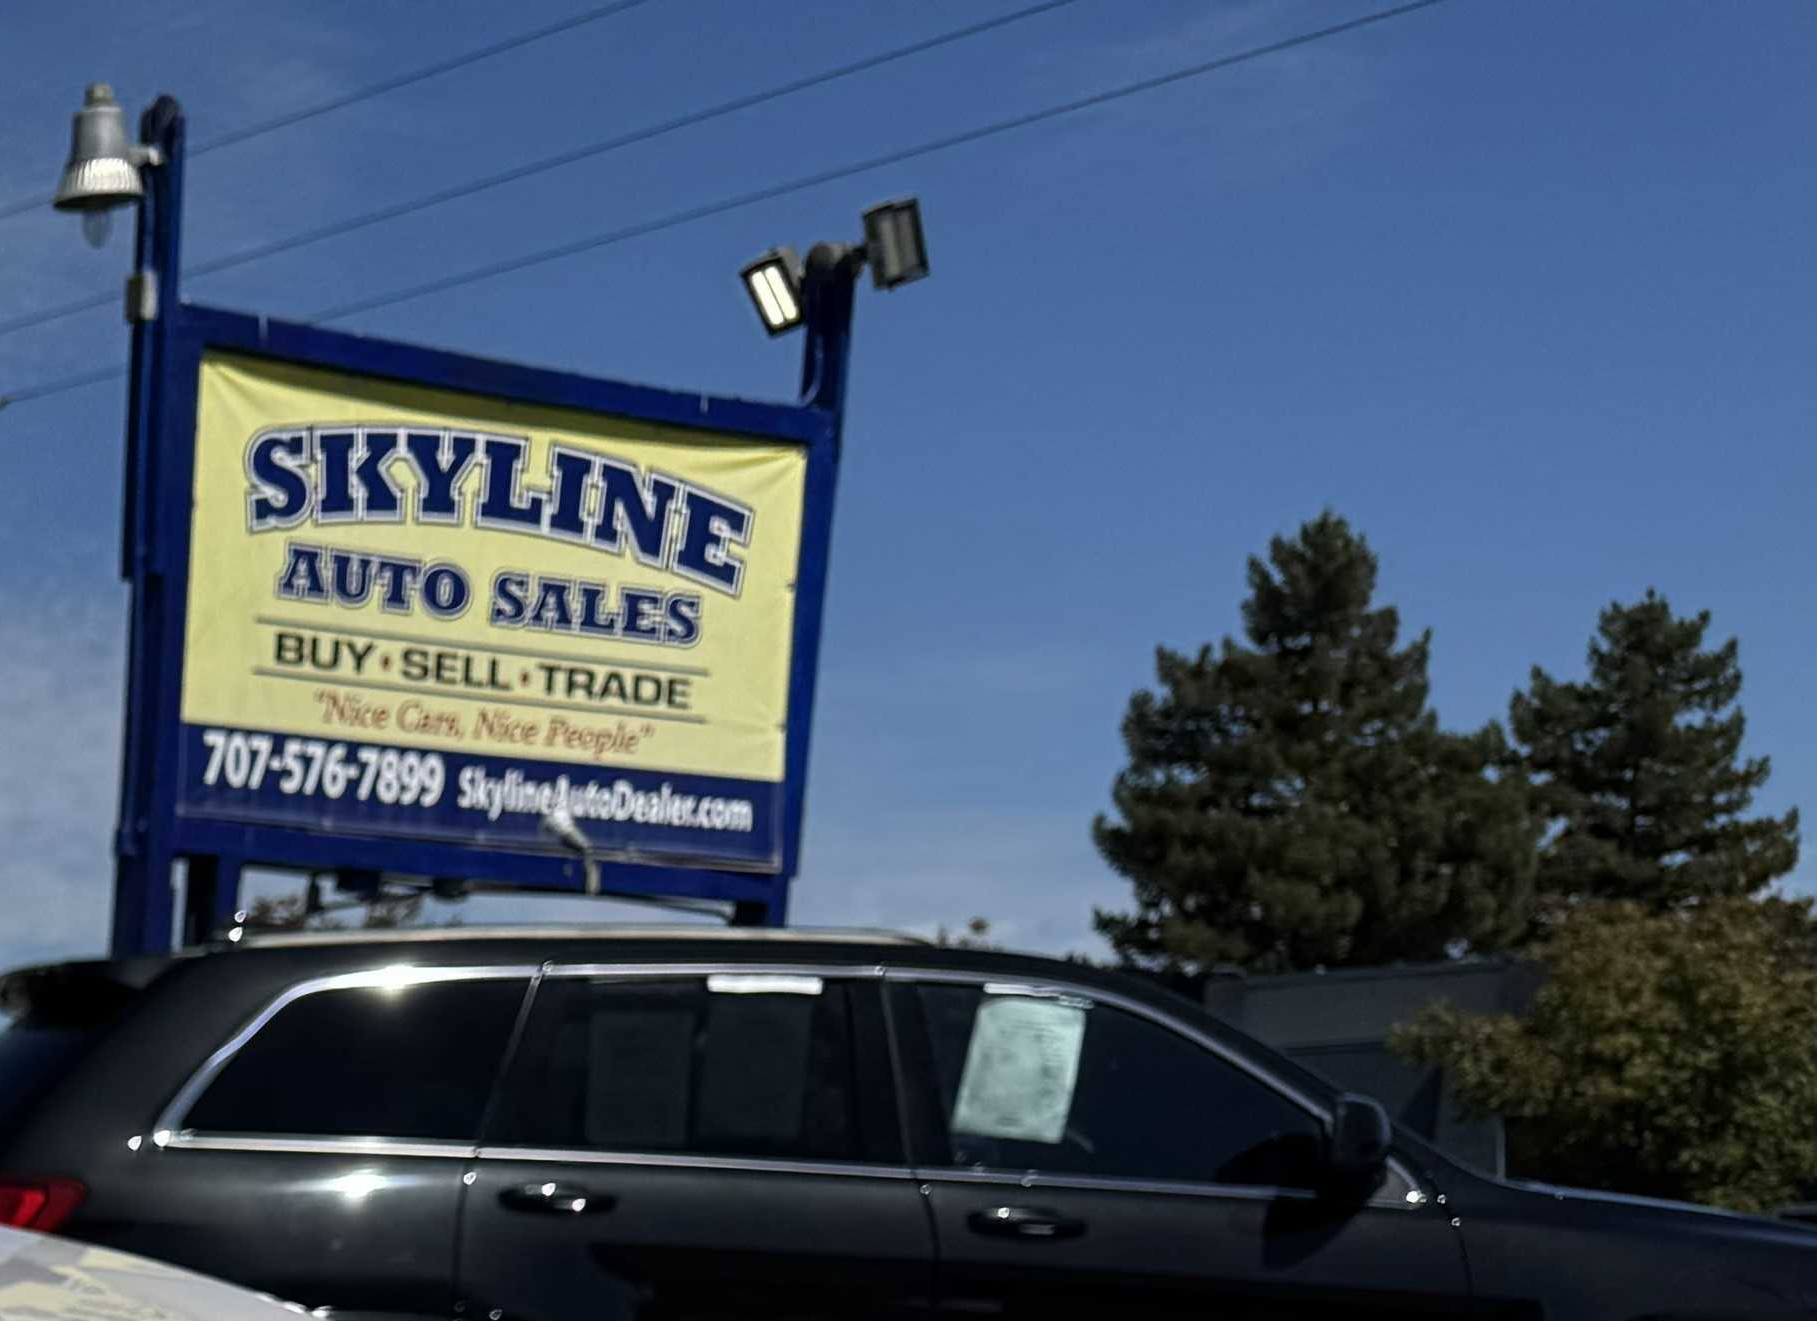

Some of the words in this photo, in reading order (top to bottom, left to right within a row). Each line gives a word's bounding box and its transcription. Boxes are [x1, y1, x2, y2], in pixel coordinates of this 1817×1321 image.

[246, 424, 753, 597] SKYLINE
[278, 542, 471, 616] AUTO
[488, 567, 702, 648] SALES
[535, 662, 691, 709] TRADE
[473, 708, 538, 744] Nice
[203, 729, 446, 807] 707-576-7899
